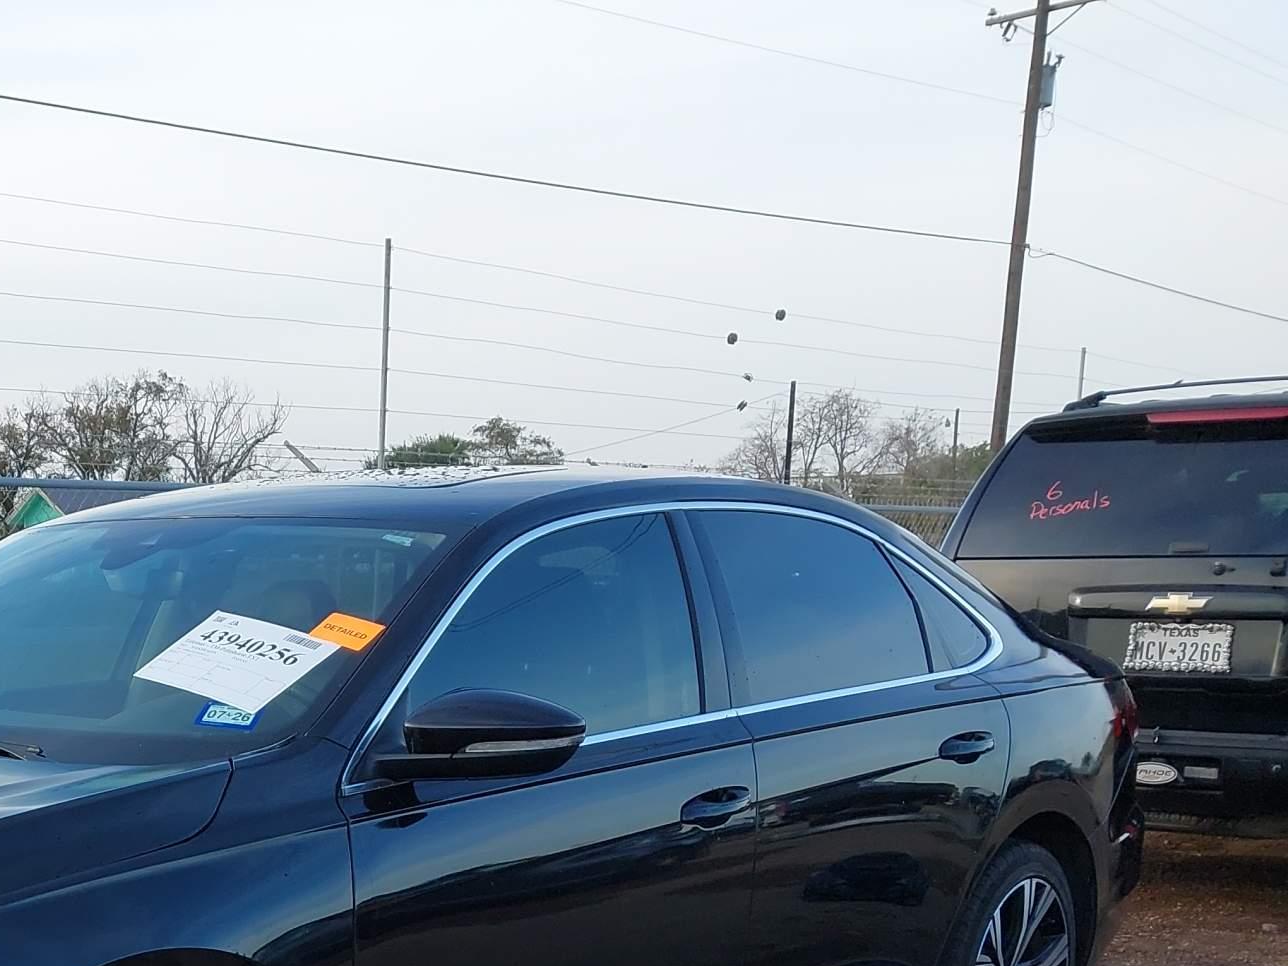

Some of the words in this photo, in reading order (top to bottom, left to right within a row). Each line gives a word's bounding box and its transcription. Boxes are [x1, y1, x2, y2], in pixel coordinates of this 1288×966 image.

[1046, 480, 1063, 501] 6
[1029, 489, 1111, 520] Personals
[322, 622, 368, 641] DETAILED
[1162, 627, 1201, 638] TEXAS
[199, 629, 306, 666] 43940256
[1137, 768, 1173, 777] AHOE
